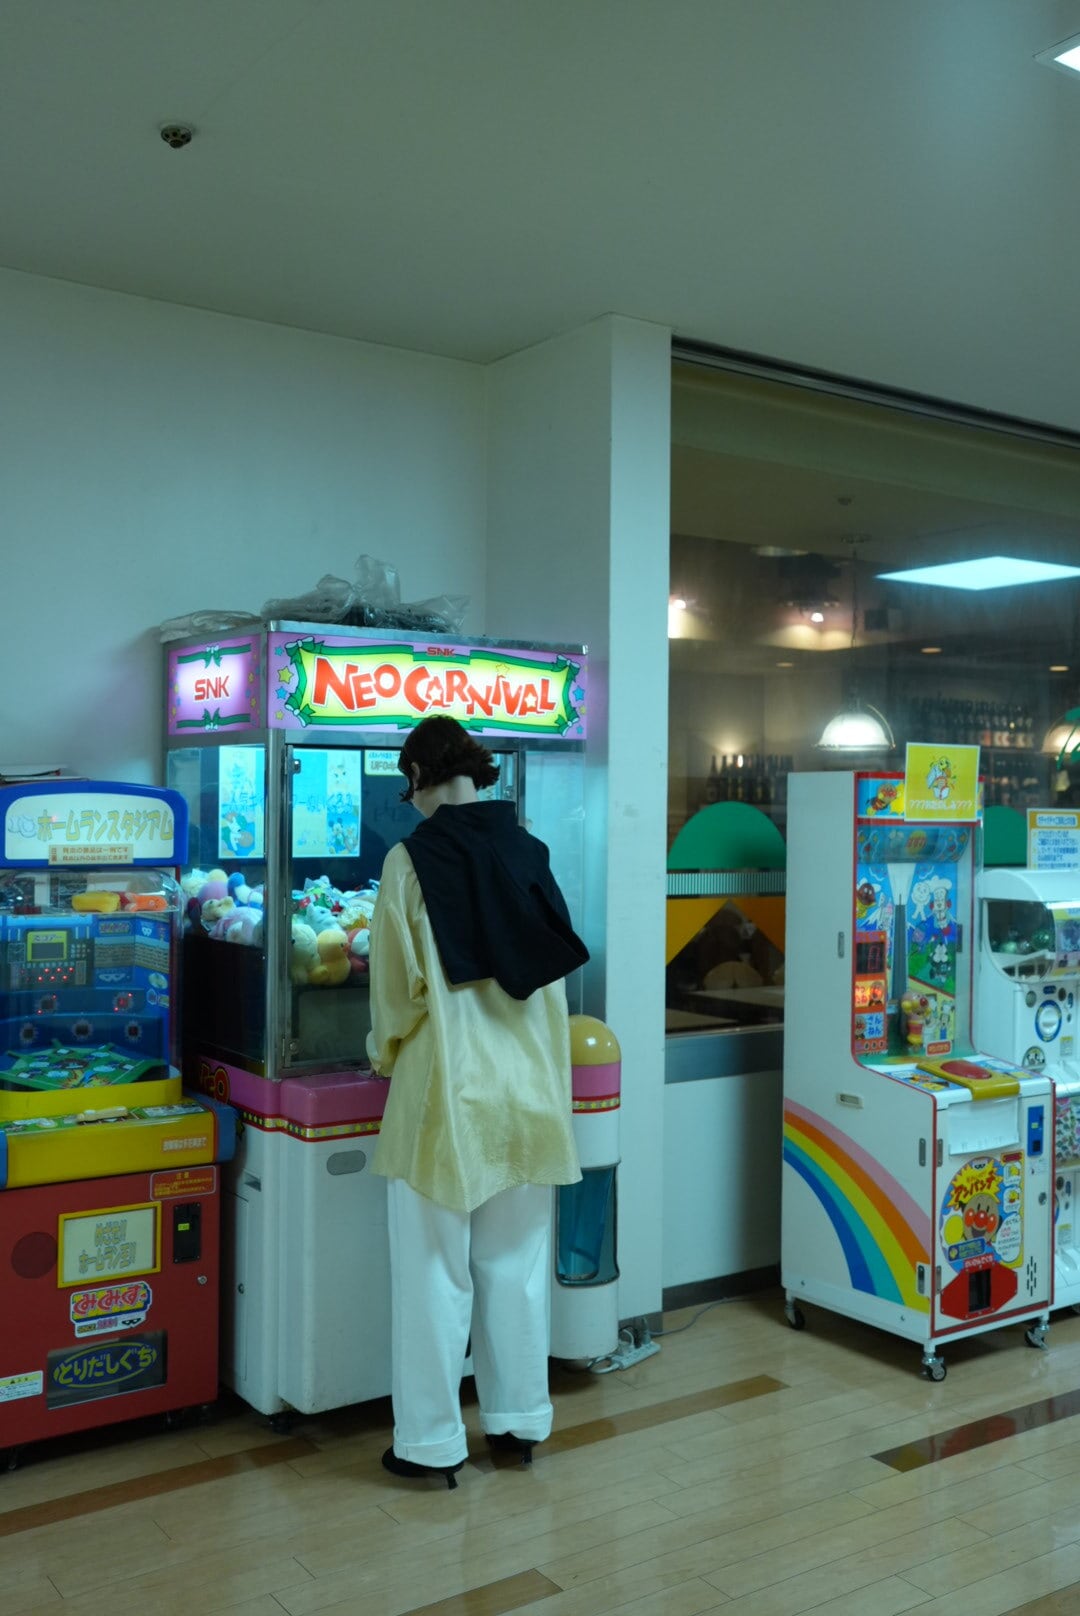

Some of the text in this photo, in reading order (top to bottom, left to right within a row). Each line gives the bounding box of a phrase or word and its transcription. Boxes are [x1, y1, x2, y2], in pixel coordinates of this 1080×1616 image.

[426, 647, 455, 657] SNK
[194, 675, 230, 701] SNK
[312, 655, 557, 717] NEO CARNIVAL
[37, 809, 174, 842] ホームランスタジアム
[59, 1346, 153, 1384] とりだしぐち
